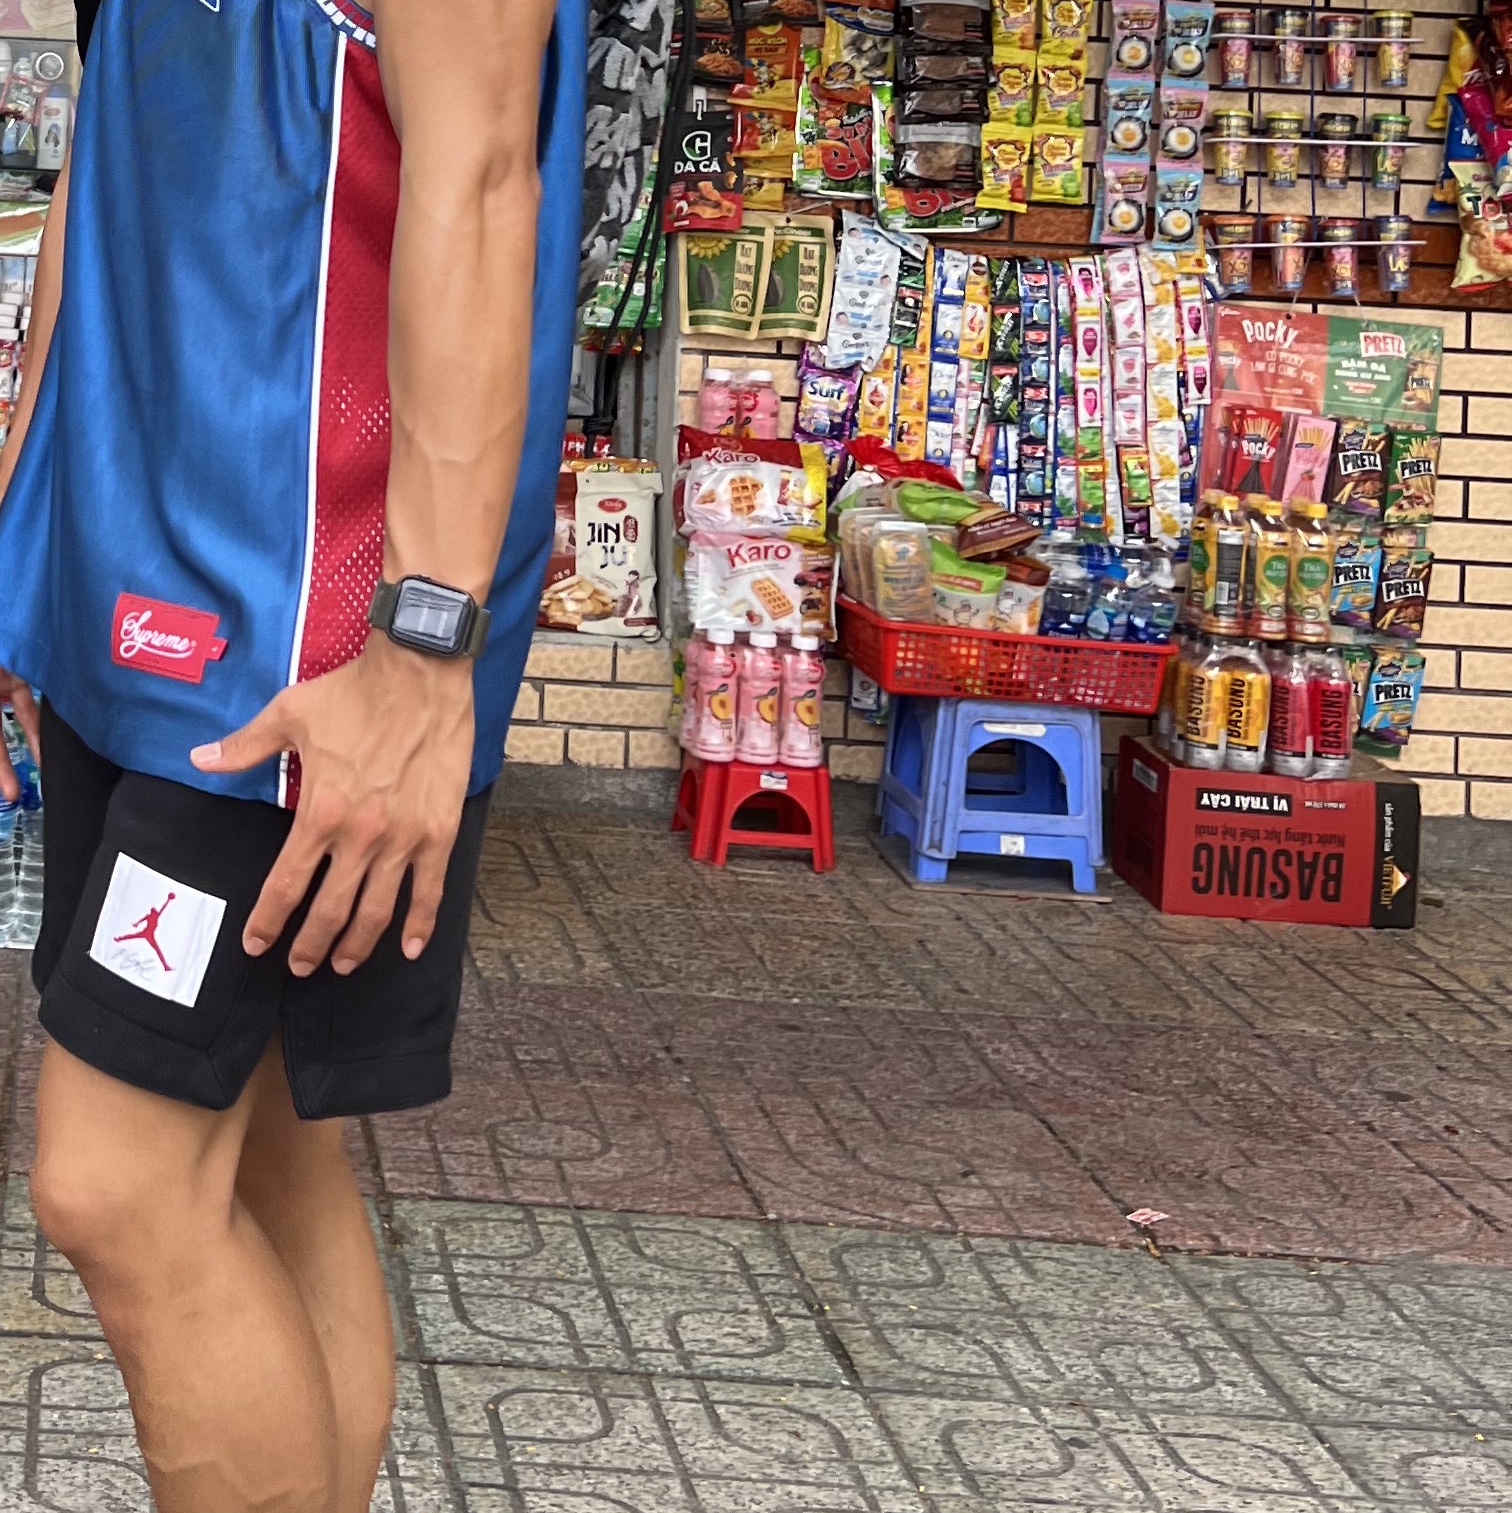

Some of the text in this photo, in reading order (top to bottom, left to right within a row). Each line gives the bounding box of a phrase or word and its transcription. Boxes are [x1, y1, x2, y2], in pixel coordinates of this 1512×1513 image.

[674, 161, 696, 174] DA
[1241, 318, 1299, 349] POCKY
[1363, 334, 1404, 355] PRETZ
[808, 379, 844, 399] Surf
[703, 447, 759, 465] Karo
[1241, 439, 1276, 459] POCKY
[1341, 452, 1380, 473] PRETZ
[1400, 459, 1433, 477] PRETZ
[586, 521, 621, 547] JIN
[727, 542, 792, 569] Karo
[1334, 565, 1372, 584] PRETZ
[1384, 581, 1422, 600] PRETZ
[119, 609, 196, 659] Supreme
[1374, 683, 1412, 701] PRETZ
[1187, 674, 1206, 737] BASUNG
[1320, 687, 1343, 749] BASUNG
[1200, 792, 1231, 809] CÂY
[1234, 794, 1270, 812] TRÁI
[1273, 794, 1289, 812] VỊ
[1287, 830, 1313, 846] tăng
[1191, 842, 1344, 903] BASUNG
